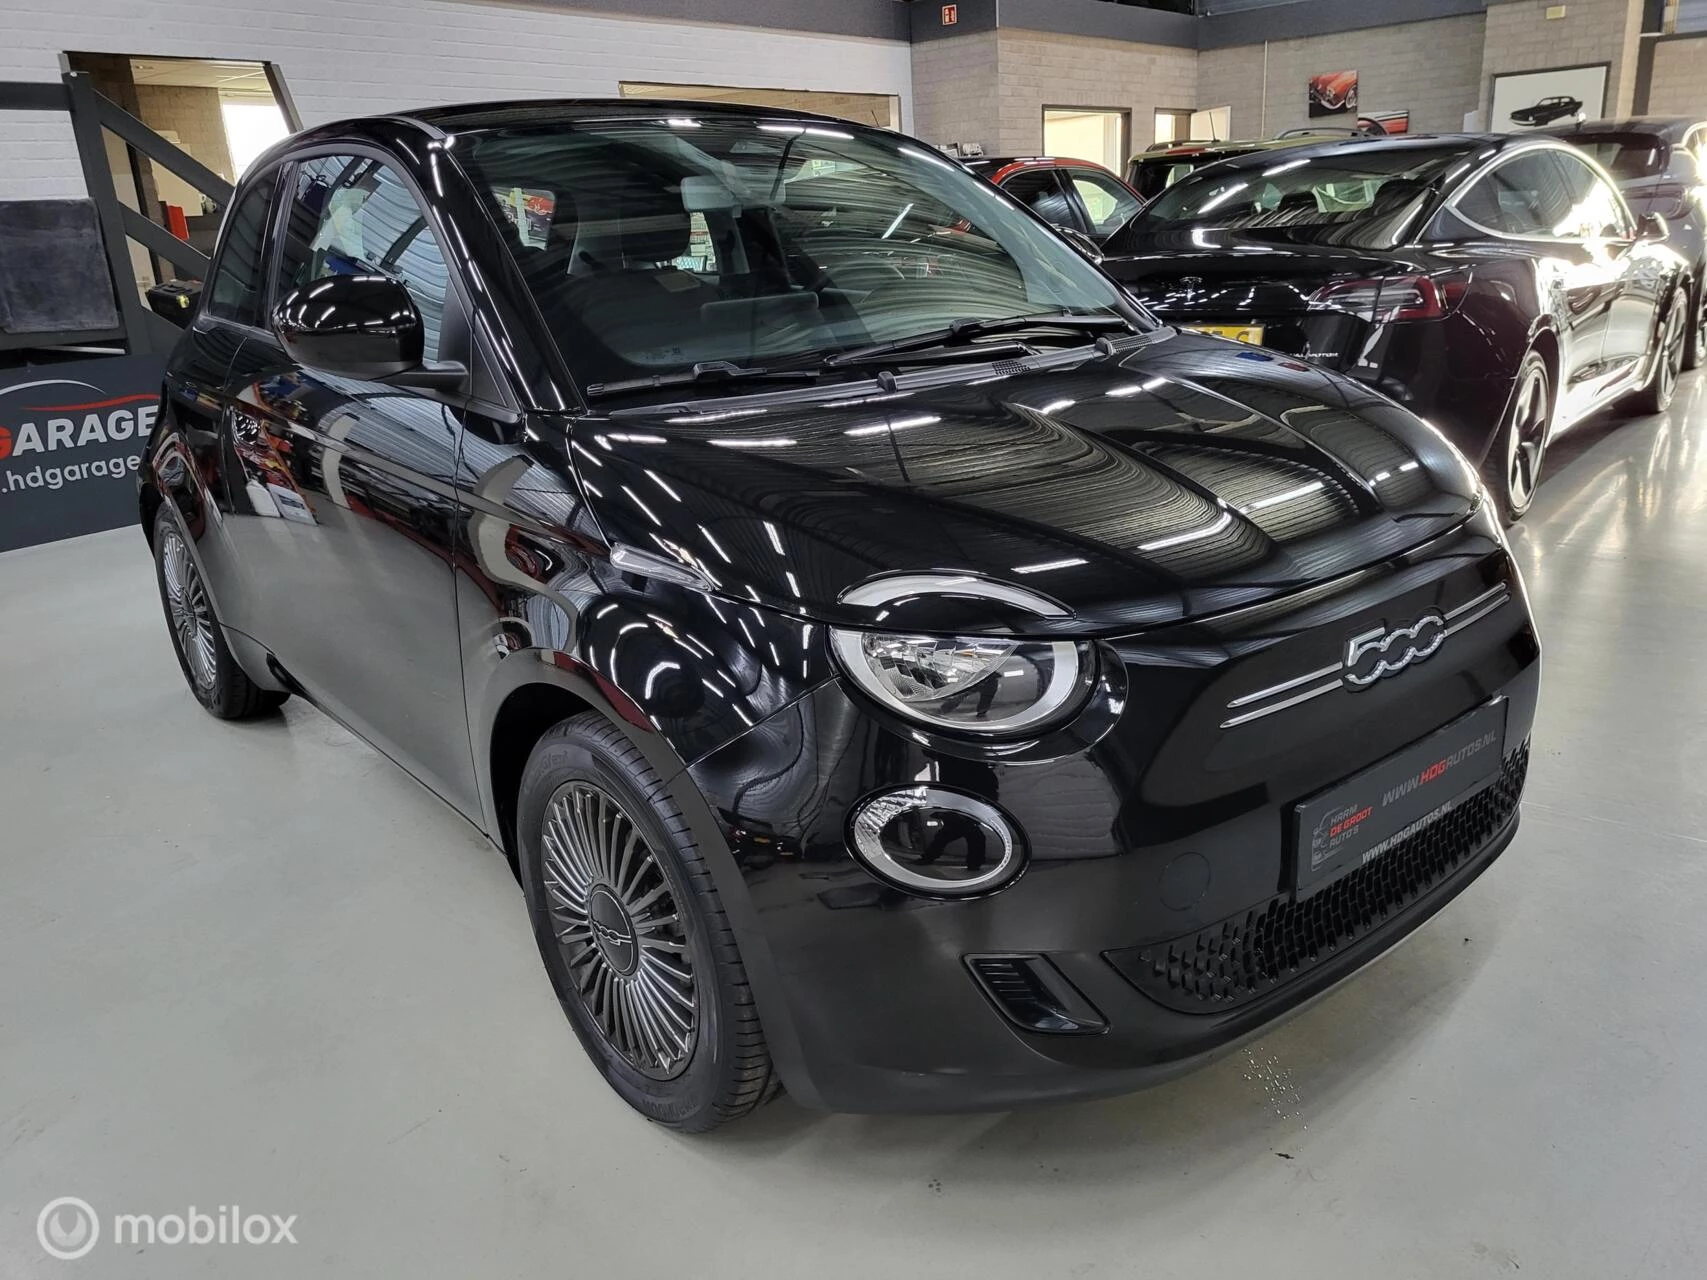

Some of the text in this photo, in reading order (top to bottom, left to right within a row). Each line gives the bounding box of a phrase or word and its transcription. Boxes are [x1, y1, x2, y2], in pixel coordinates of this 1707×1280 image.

[1345, 616, 1447, 685] 500
[1382, 730, 1497, 807] WWW.HDGAUTOS.NL
[1329, 806, 1374, 838] DE GROOT
[1361, 801, 1453, 865] WWW.HDGAUTOS.NL
